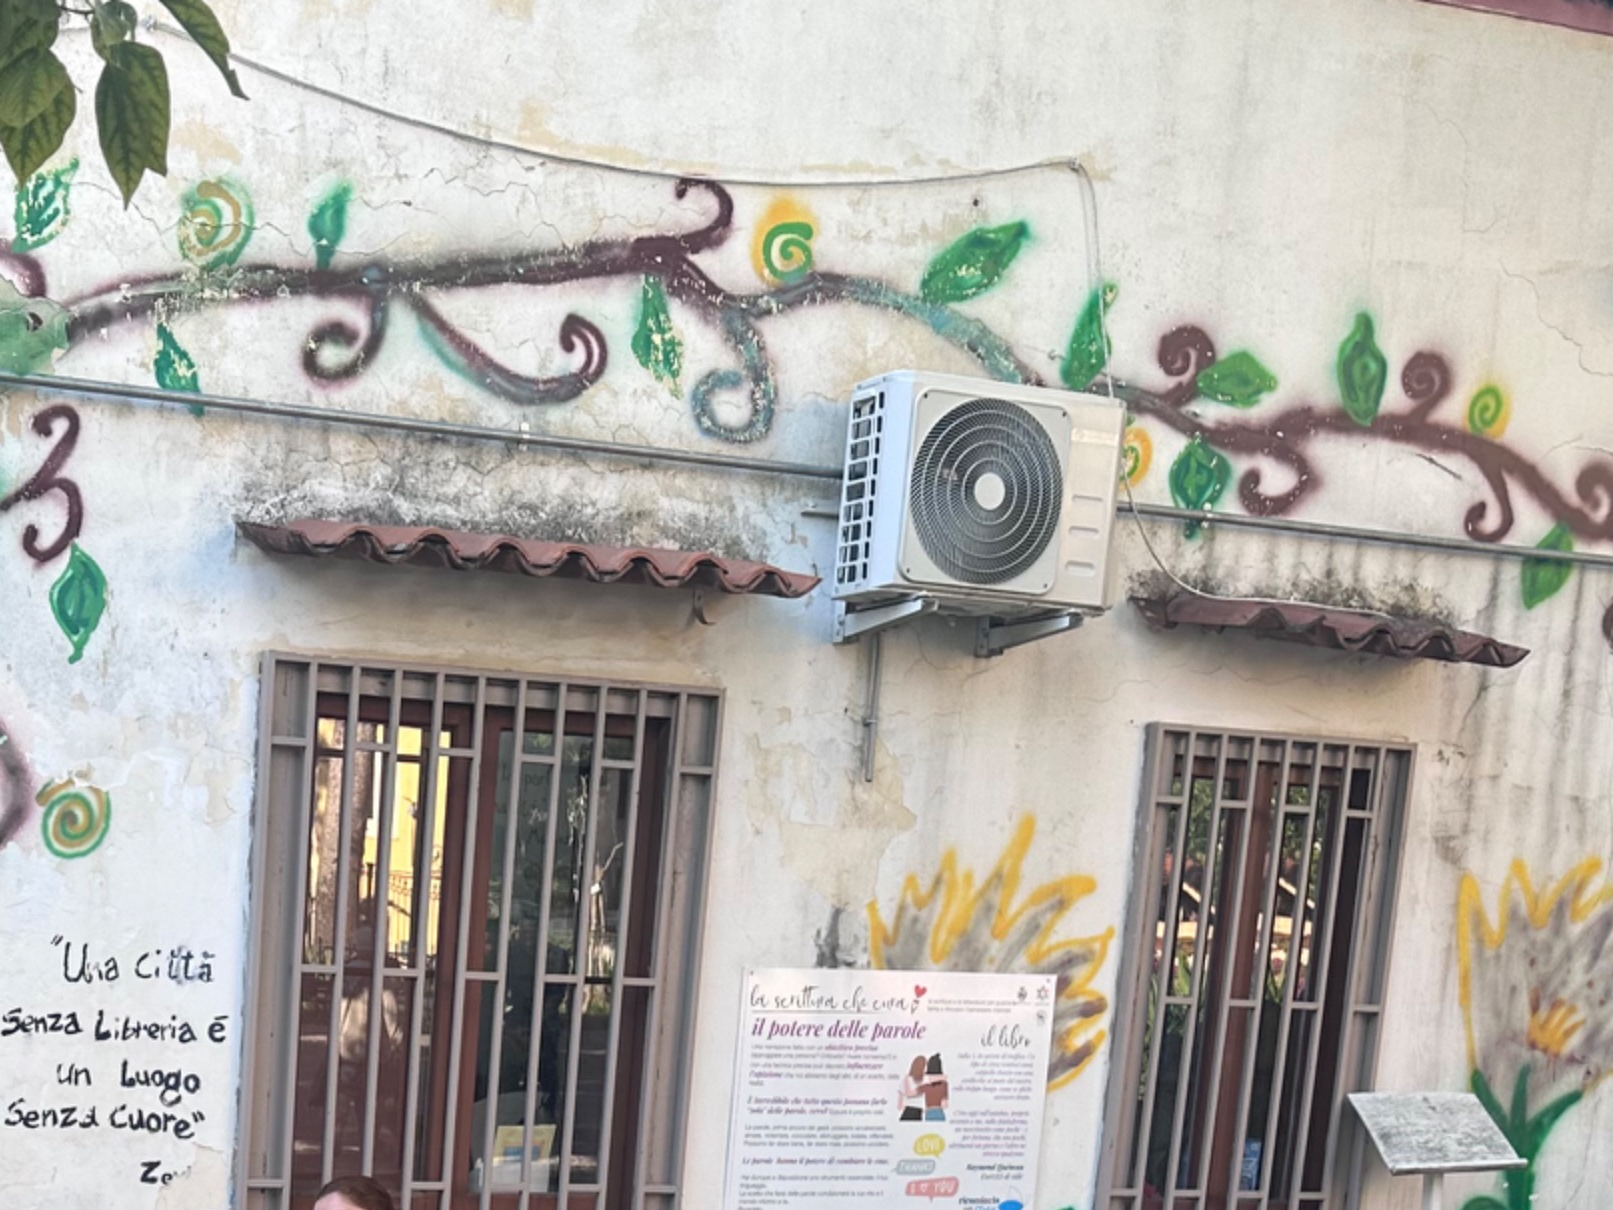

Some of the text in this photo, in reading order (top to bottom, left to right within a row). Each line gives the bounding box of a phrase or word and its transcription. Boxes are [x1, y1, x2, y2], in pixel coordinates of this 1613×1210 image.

[751, 1017, 927, 1042] il potere delle parole
